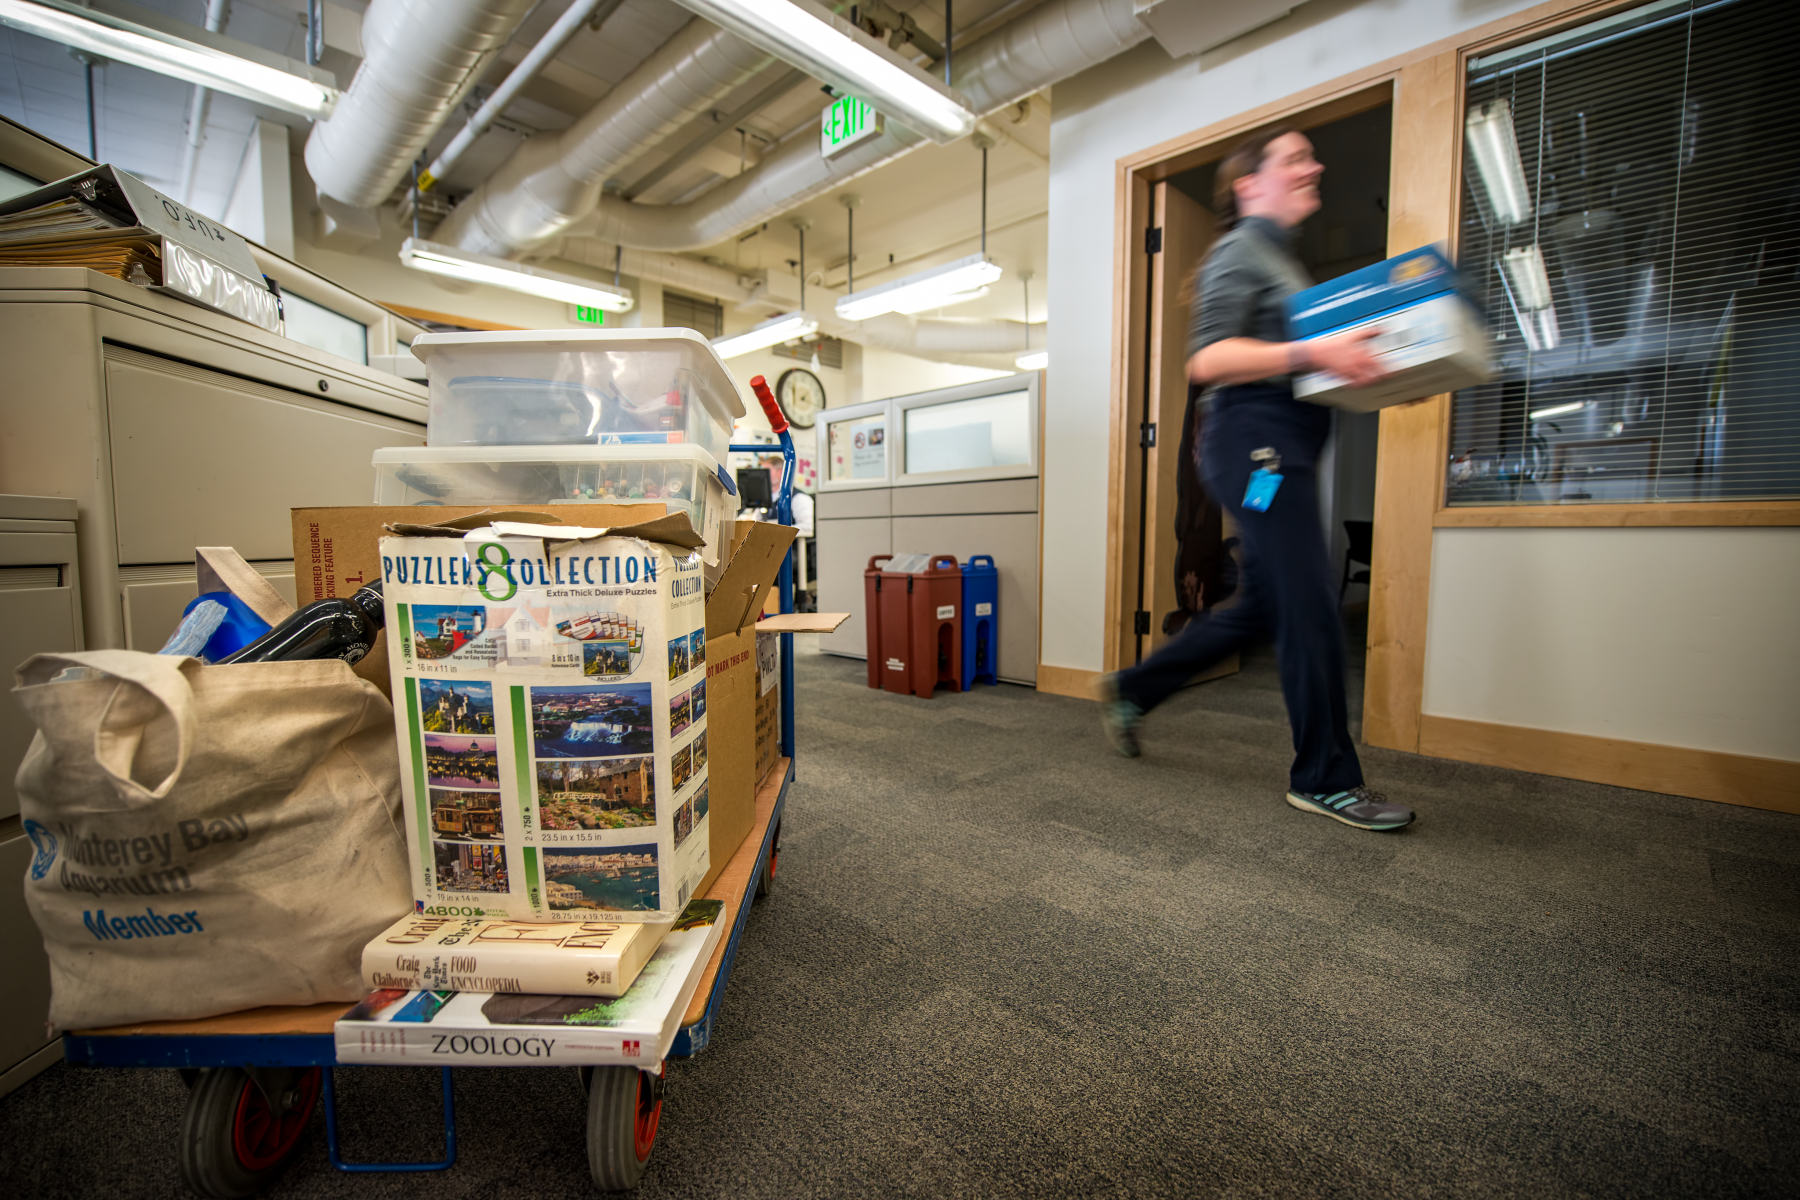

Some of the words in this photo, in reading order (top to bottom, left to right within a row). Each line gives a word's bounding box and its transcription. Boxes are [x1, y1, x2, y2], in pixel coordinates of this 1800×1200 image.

[831, 95, 864, 145] EXIT
[310, 522, 321, 564] SEQUENCE
[324, 538, 334, 572] FEATURE
[478, 542, 518, 601] 8
[506, 556, 658, 585] COLLECTION
[313, 566, 323, 600] MBERED
[326, 574, 336, 598] CKING
[546, 590, 568, 598] Extra
[595, 588, 624, 596] Deluxe
[626, 588, 658, 596] Puzzles
[403, 643, 412, 658] 300
[567, 654, 574, 662] 10
[418, 664, 426, 672] 16
[427, 664, 433, 672] in
[450, 665, 458, 673] in
[715, 659, 730, 675] MARK
[730, 654, 740, 668] THIS
[741, 650, 750, 662] END
[524, 815, 532, 829] 750
[178, 813, 249, 853] Bay
[531, 893, 540, 908] 1000
[425, 906, 473, 917] 4800
[84, 907, 204, 941] Member
[386, 919, 457, 944] Crai
[396, 954, 420, 974] Craig
[451, 956, 477, 974] FOOD
[372, 972, 421, 988] Claiborne's
[451, 976, 522, 992] ENCYCLOPEDIA
[432, 1034, 556, 1057] ZOOLOGY
